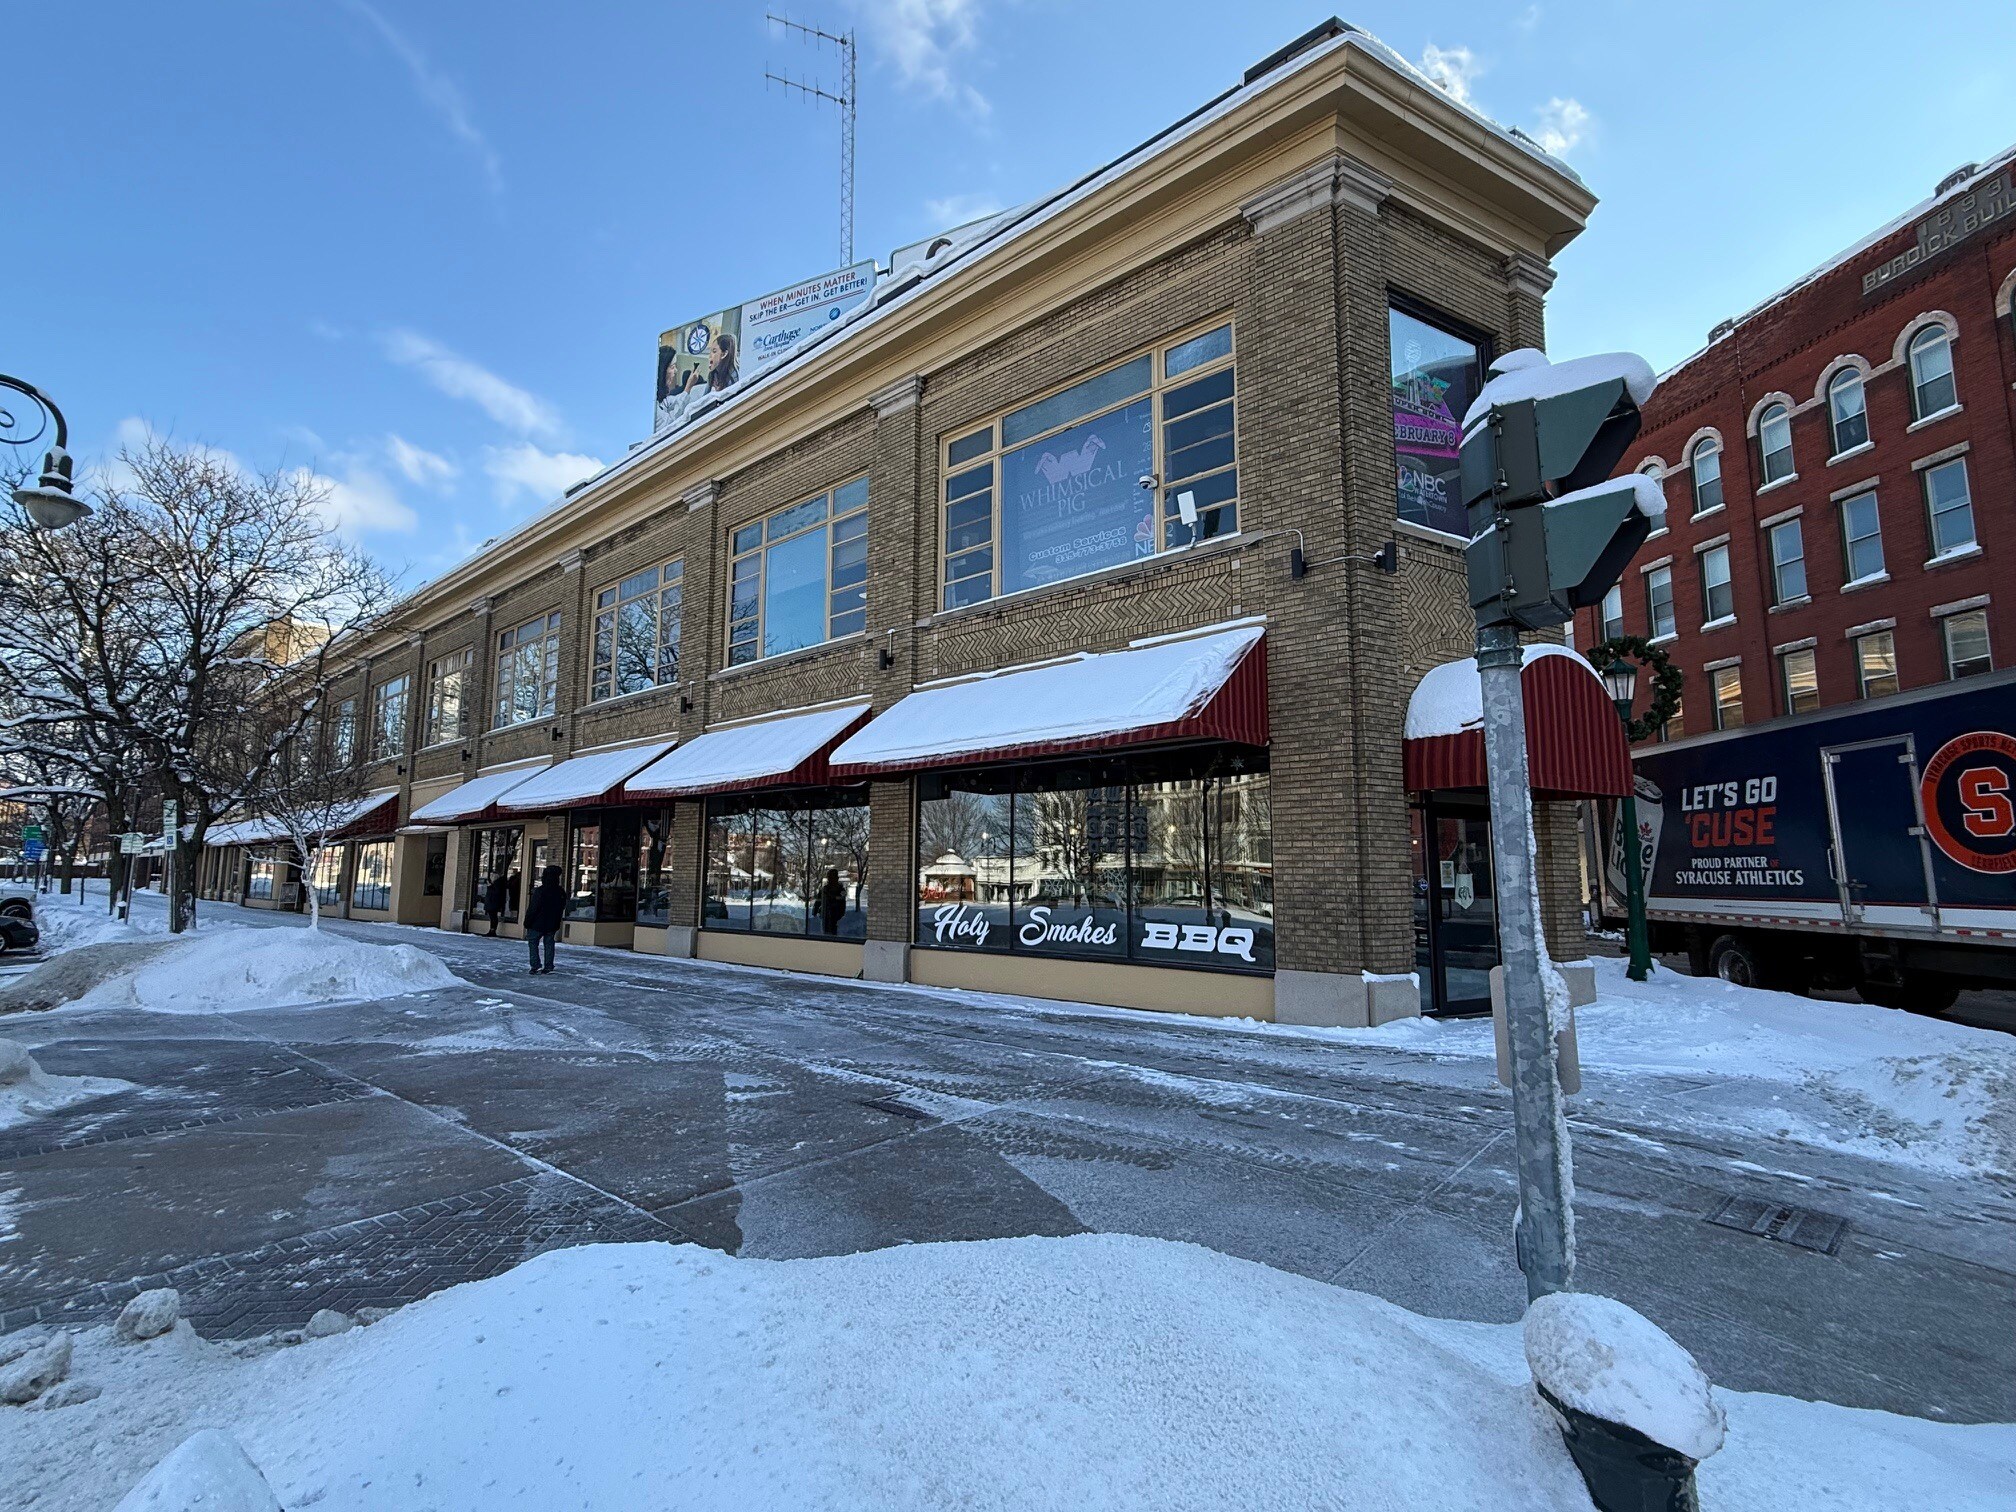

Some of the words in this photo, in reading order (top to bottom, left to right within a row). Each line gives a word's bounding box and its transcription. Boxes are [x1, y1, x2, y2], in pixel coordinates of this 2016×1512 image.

[1864, 225, 1959, 290] BURDICK
[1963, 193, 2016, 233] BUIL
[749, 310, 764, 322] SKIP
[765, 306, 777, 317] THE
[823, 287, 838, 298] GET
[840, 277, 867, 293] BETTER!
[760, 296, 784, 310] WHEN
[786, 283, 821, 301] MINUTES
[823, 271, 856, 289] MATTER
[763, 328, 800, 347] Carthage
[1393, 397, 1419, 412] UPER
[1394, 424, 1446, 444] EBRUARY
[1447, 429, 1456, 446] 8
[1020, 460, 1127, 511] WHIMSICAL
[1413, 470, 1447, 496] NBC
[1057, 492, 1085, 517] PIG
[1029, 543, 1071, 562] Custom
[1682, 782, 1738, 811] LET'S
[1745, 776, 1777, 804] GO
[1691, 857, 1722, 869] PROUD
[1724, 856, 1768, 869] PARTNER
[1770, 859, 1780, 869] OF
[1676, 871, 1732, 885] SYRACUSE
[1735, 870, 1804, 886] ATHLETICS
[934, 903, 991, 946] Holy
[1019, 906, 1117, 946] Smokes
[1140, 922, 1257, 962] BBQ
